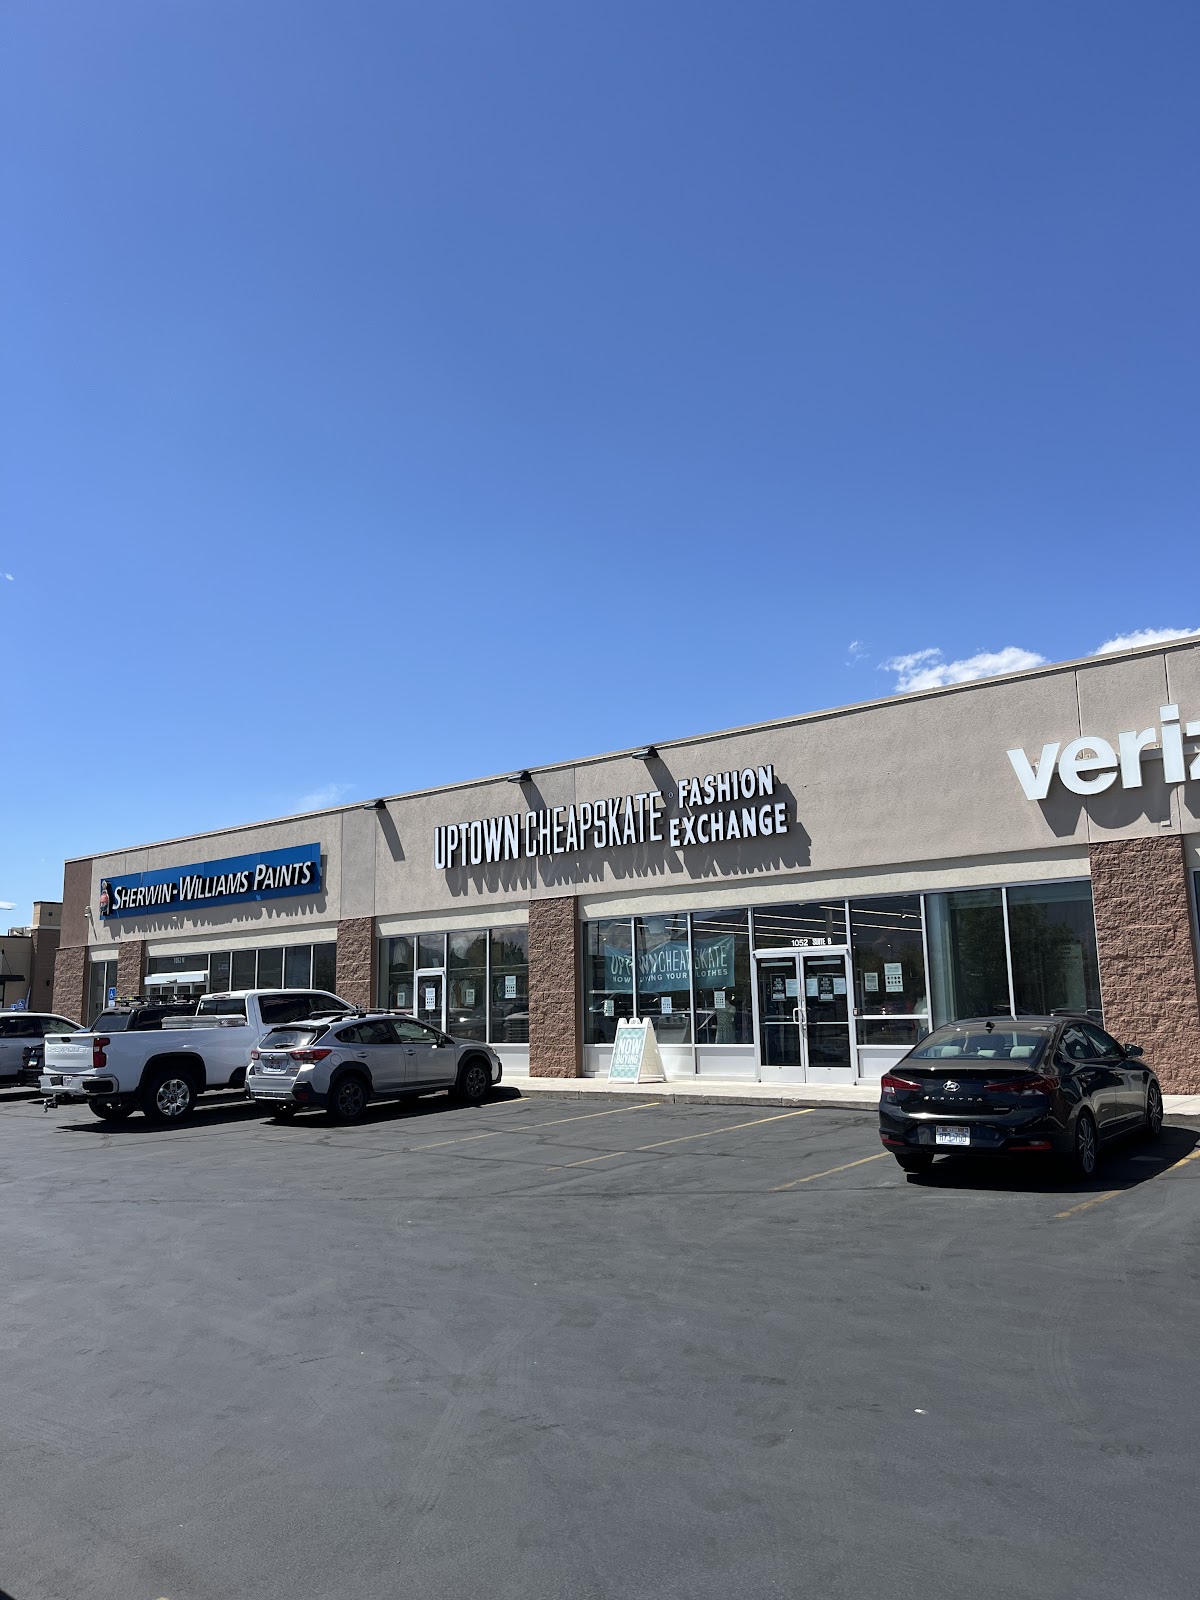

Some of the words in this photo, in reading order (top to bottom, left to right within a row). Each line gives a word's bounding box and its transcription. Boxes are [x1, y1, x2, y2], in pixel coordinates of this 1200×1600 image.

[1006, 703, 1200, 800] veri
[677, 764, 774, 809] FASHION
[433, 813, 520, 870] UPTOWN
[525, 790, 664, 858] CHEAPSKATE
[668, 802, 789, 848] EXCHANGE
[112, 870, 249, 910] SHERWIN-WILLIAMS
[253, 861, 312, 891] PAINTS
[791, 938, 808, 946] 1052
[827, 937, 832, 945] B
[666, 971, 688, 980] YOUR
[695, 968, 728, 978] LOTHES
[46, 1046, 90, 1054] CHEVROLET
[615, 1054, 639, 1064] BUYING
[617, 1038, 642, 1055] NOW
